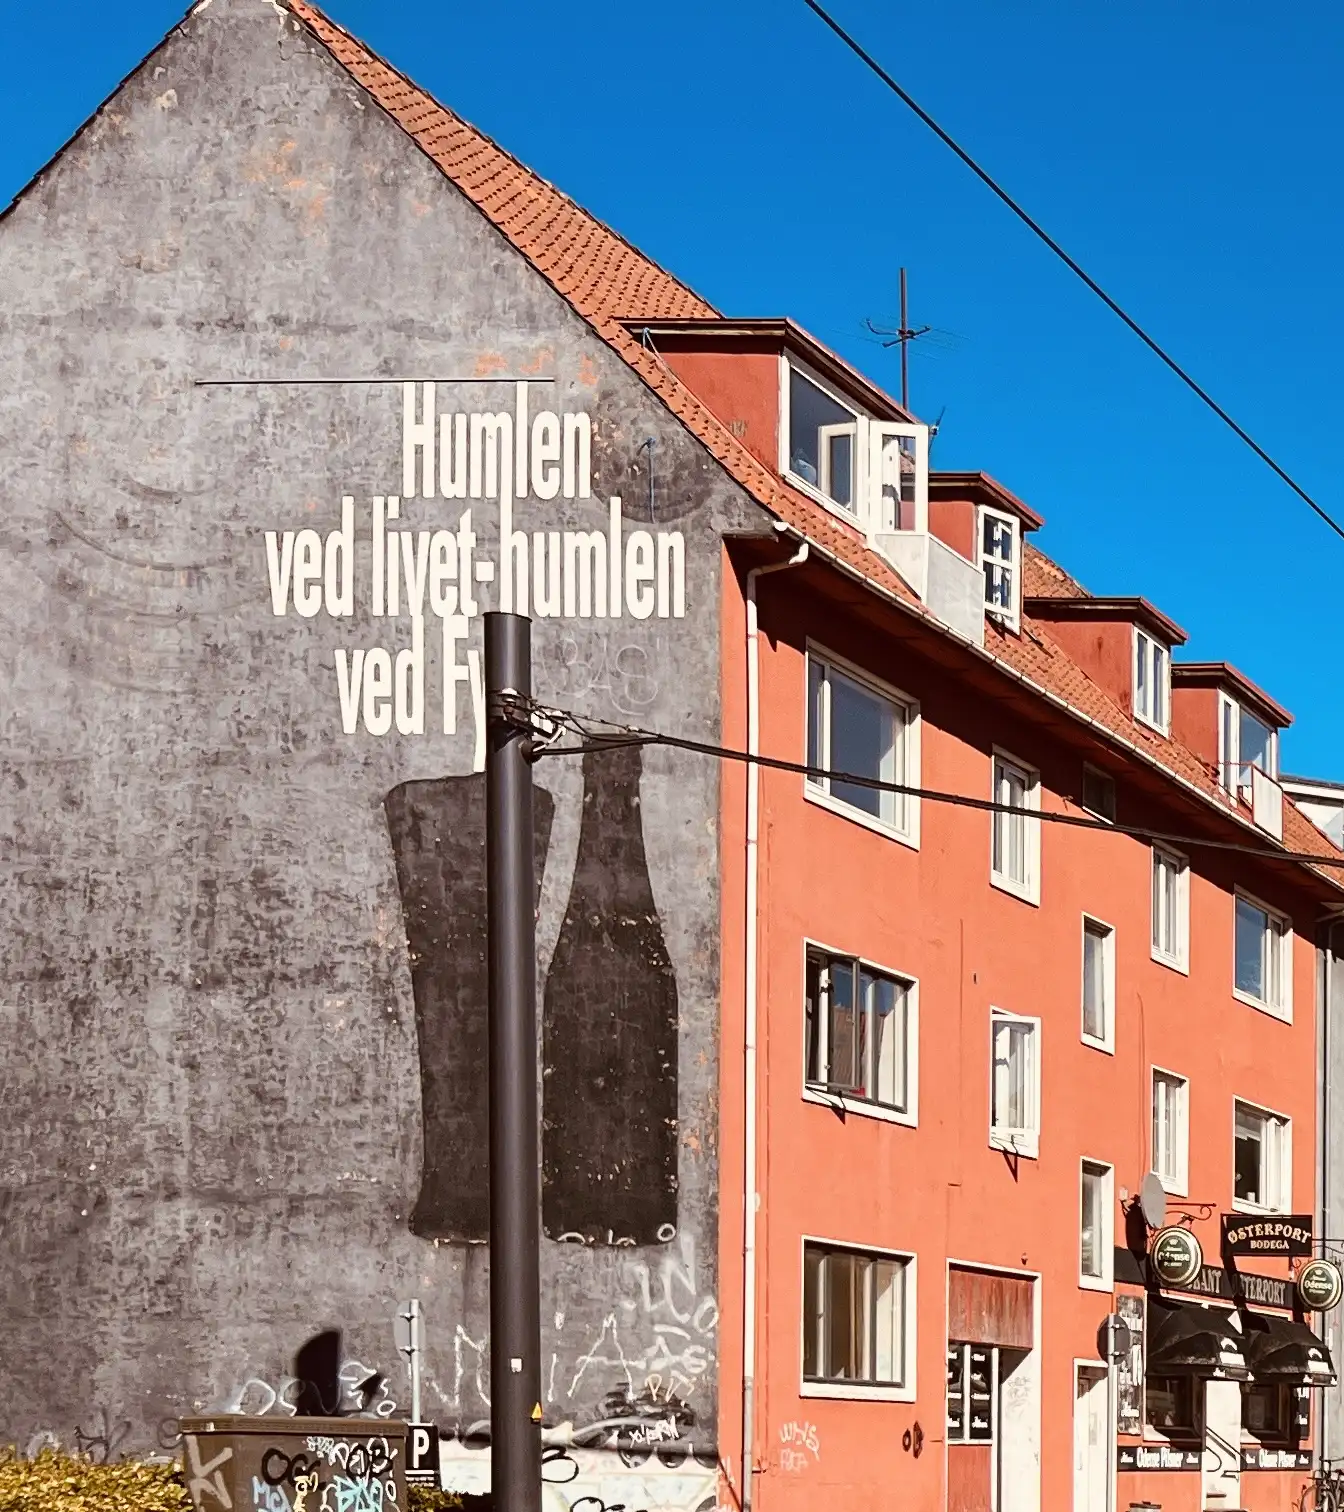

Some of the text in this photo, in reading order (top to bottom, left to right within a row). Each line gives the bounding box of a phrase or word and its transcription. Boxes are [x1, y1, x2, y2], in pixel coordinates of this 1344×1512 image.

[403, 381, 592, 499] Humlen
[265, 496, 354, 618] ved
[335, 614, 424, 736] ved
[444, 614, 487, 774] Fy
[1227, 1223, 1312, 1244] ØSTERPORT
[1250, 1240, 1290, 1250] BODEGA
[413, 1428, 430, 1469] P
